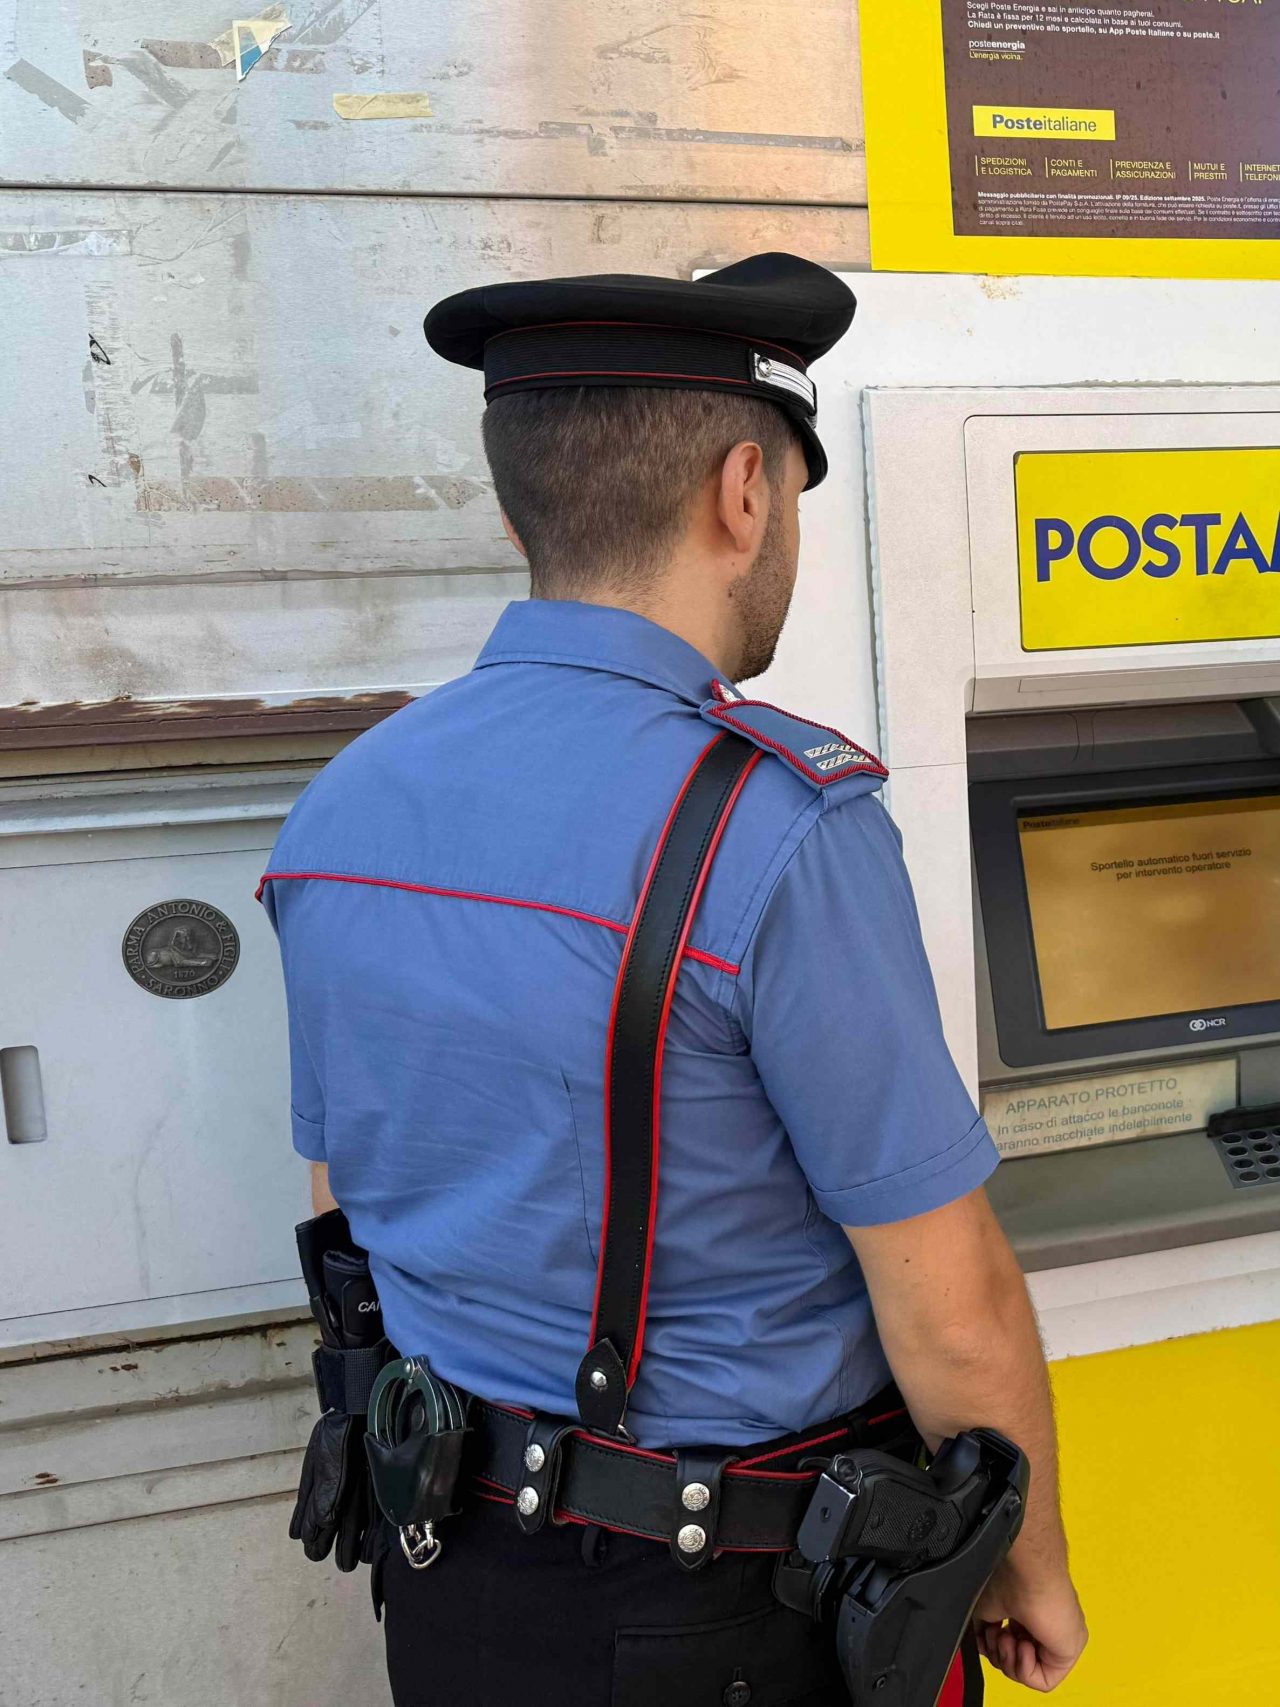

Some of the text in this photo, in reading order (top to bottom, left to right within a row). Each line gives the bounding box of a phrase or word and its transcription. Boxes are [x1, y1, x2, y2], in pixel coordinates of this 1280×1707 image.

[967, 1, 989, 11] Scegli
[1013, 4, 1039, 13] Energia
[1068, 7, 1096, 15] anticipo
[1098, 9, 1121, 17] quanto
[1003, 12, 1019, 20] fissa
[1021, 14, 1033, 22] per
[1071, 16, 1102, 24] calcolata
[968, 20, 992, 28] Chiedi
[1005, 23, 1044, 31] preventivo
[1062, 25, 1097, 34] sportello,
[1109, 27, 1124, 36] App
[1125, 28, 1146, 36] Poste
[1148, 29, 1174, 37] Italiane
[969, 40, 1025, 50] posteenergia
[969, 51, 999, 60] L'energia
[992, 114, 1097, 132] Posteitaliane
[980, 157, 1027, 166] SPEDIZIONI
[1050, 158, 1083, 168] CONTI E
[1115, 161, 1171, 170] PREVIDENZA E
[981, 167, 1032, 176] E LOGISTICA
[1193, 163, 1225, 171] MUTUI E
[1244, 163, 1280, 172] INTERNET
[1051, 168, 1097, 177] PAGAMENTI
[1115, 170, 1176, 179] ASSICURAZIONI
[1194, 172, 1227, 180] PRESTITI
[977, 191, 1009, 200] Messaggio
[1091, 848, 1251, 872] Sportello automatico fuori servizio
[1116, 861, 1231, 881] per intervento operatore
[127, 902, 235, 973] PARMA ANTONIO & FIGLI
[145, 976, 218, 996] SARONNO
[1207, 1018, 1226, 1027] NCR
[1006, 1078, 1178, 1115] APPARATO PROTETTO
[998, 1099, 1183, 1136] In caso di attacco le banconote
[996, 1112, 1193, 1151] aranno macchiate indelebilmente
[358, 1301, 380, 1312] CA
